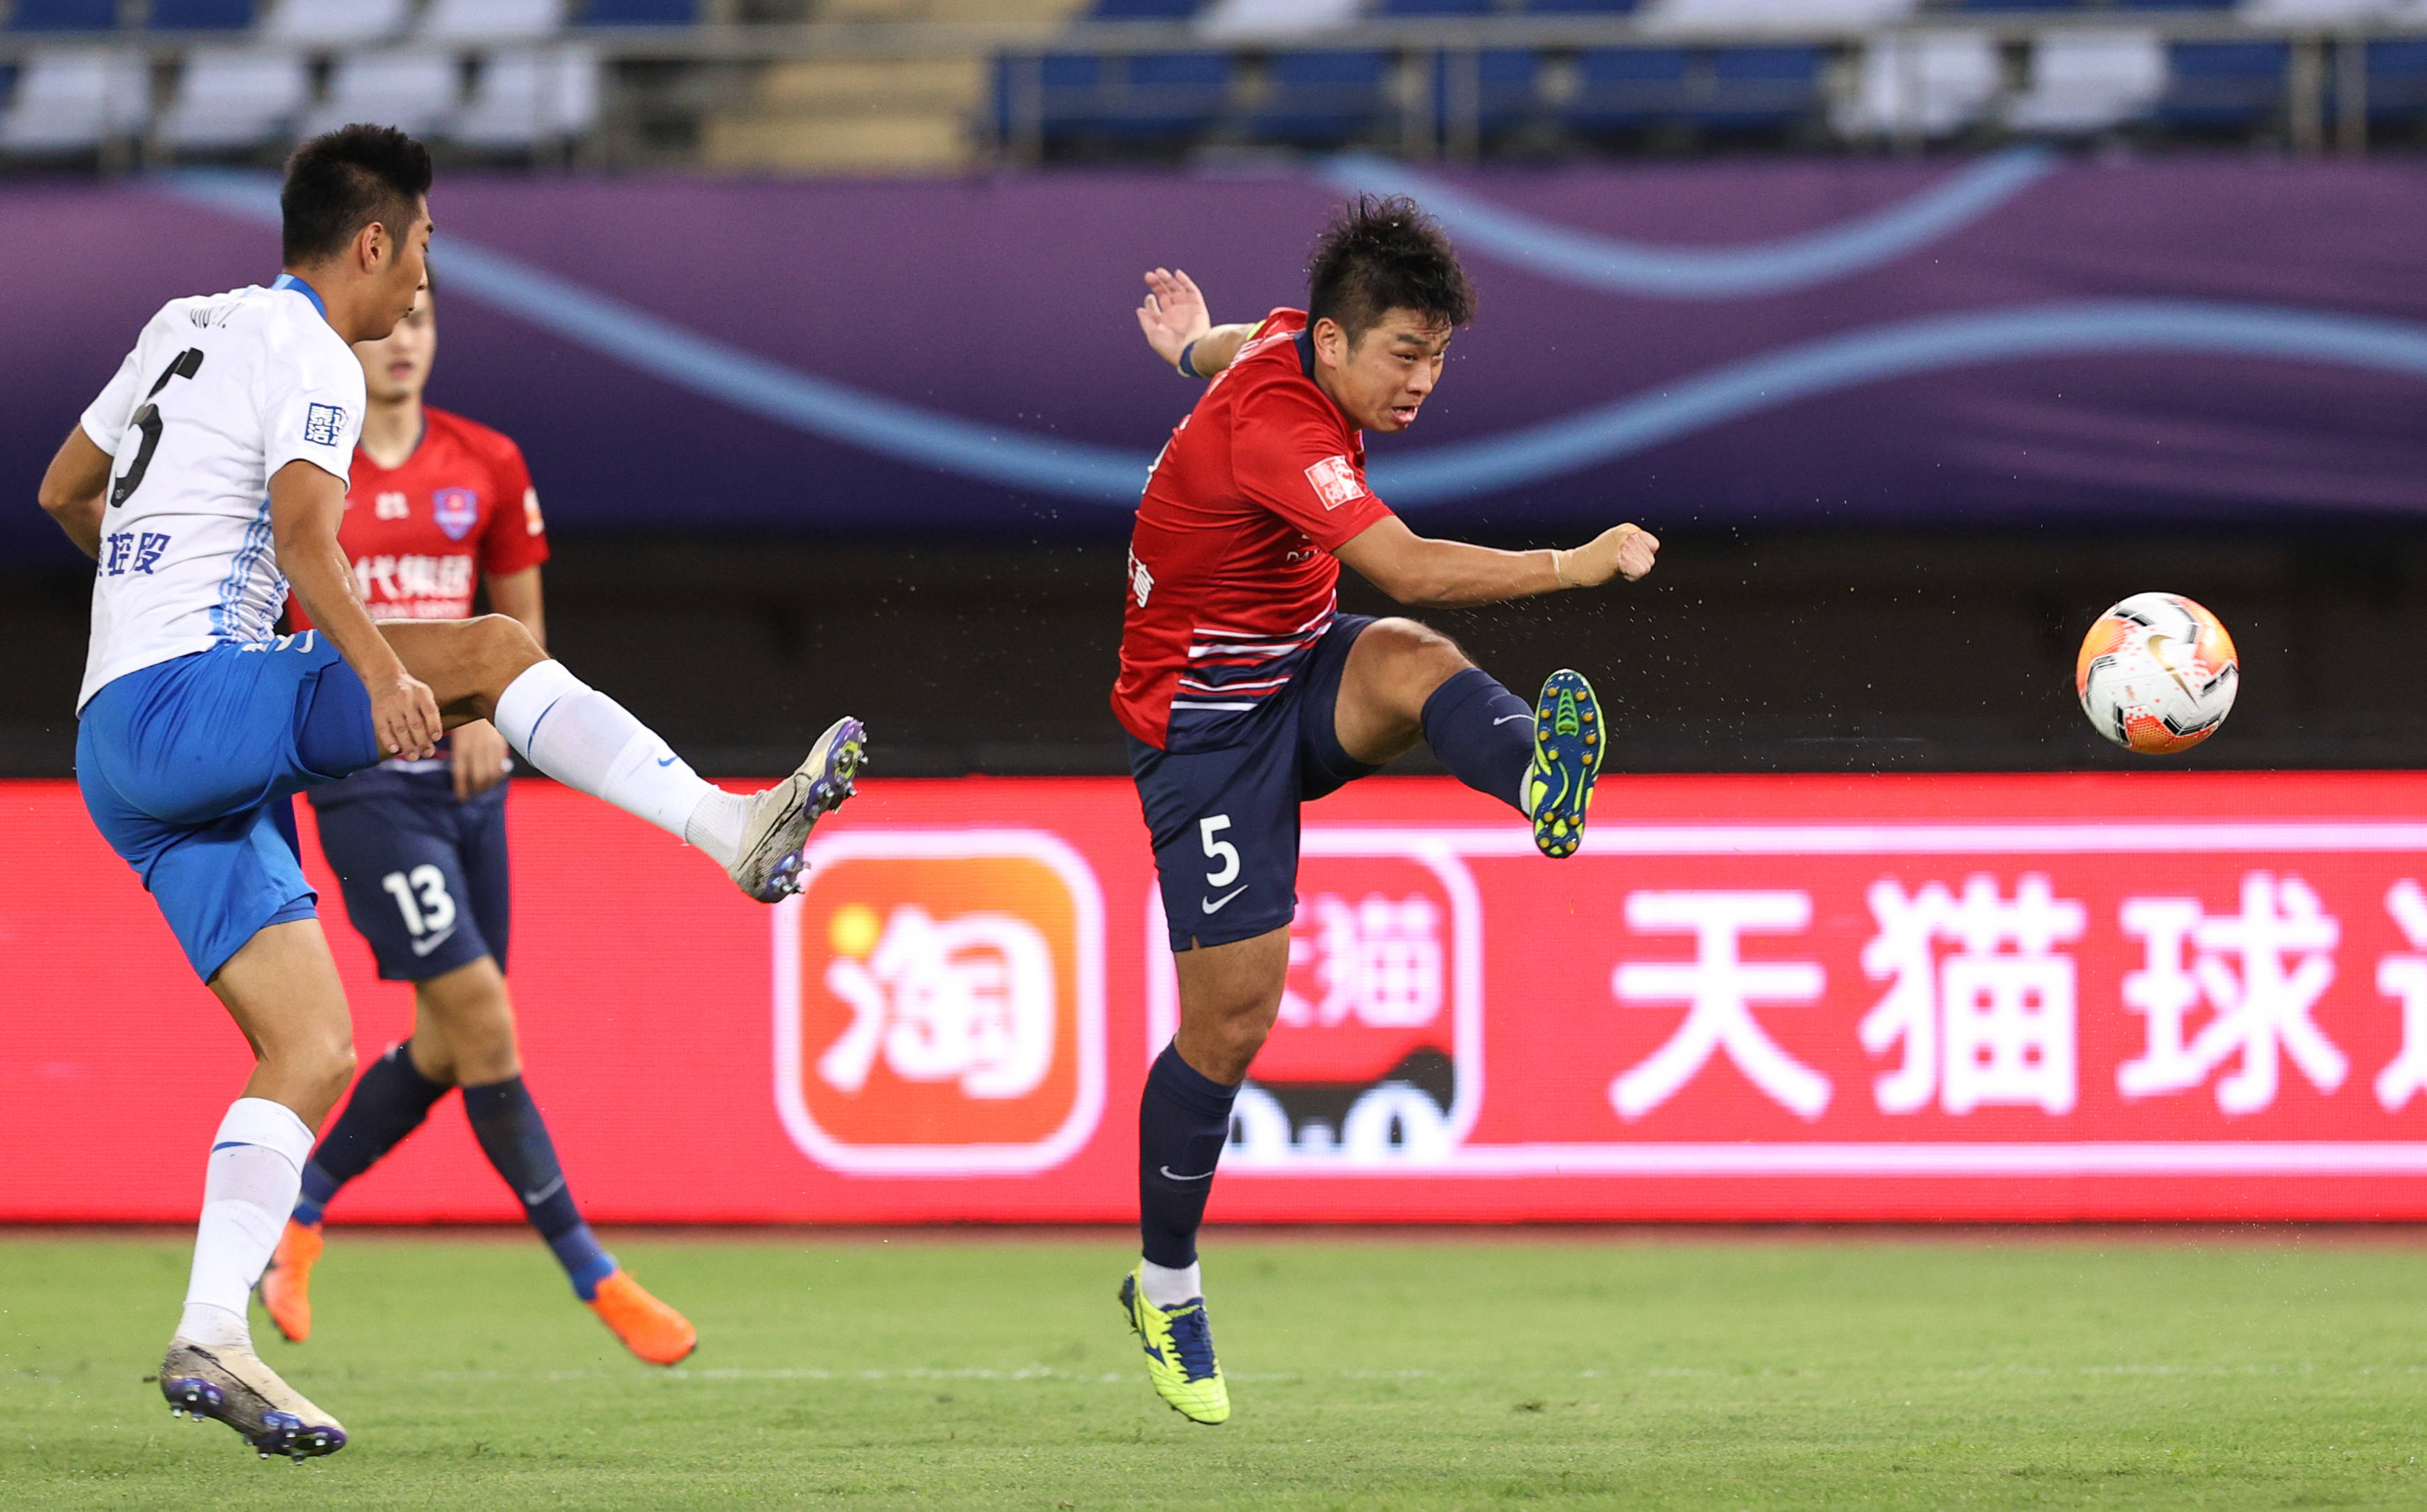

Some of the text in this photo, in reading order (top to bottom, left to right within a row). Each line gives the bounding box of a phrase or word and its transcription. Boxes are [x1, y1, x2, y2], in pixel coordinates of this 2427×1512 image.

[98, 532, 172, 577] 控股
[1199, 814, 1241, 888] 5
[382, 864, 456, 937] 13
[817, 903, 1057, 1100] 淘
